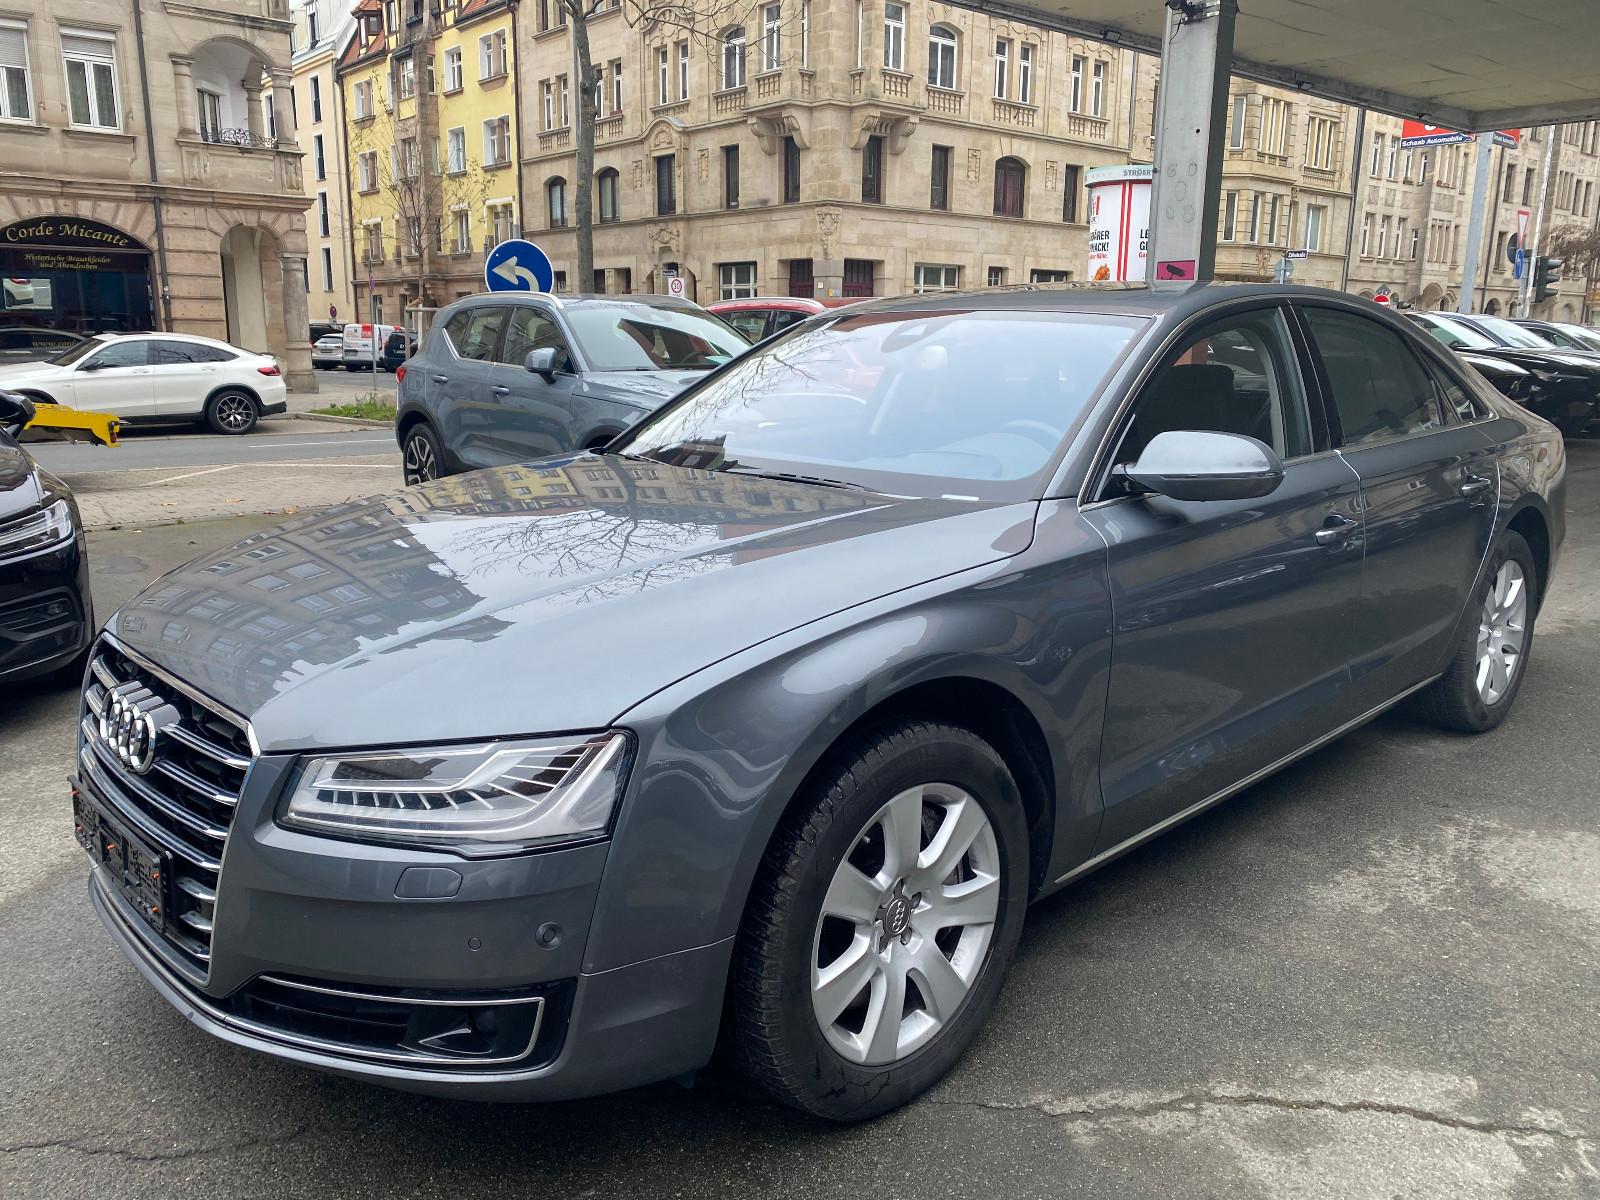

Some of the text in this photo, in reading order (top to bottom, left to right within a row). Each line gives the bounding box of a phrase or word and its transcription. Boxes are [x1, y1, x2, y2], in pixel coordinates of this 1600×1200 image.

[1402, 139, 1425, 147] Schaab
[6, 222, 129, 246] Corde Micante
